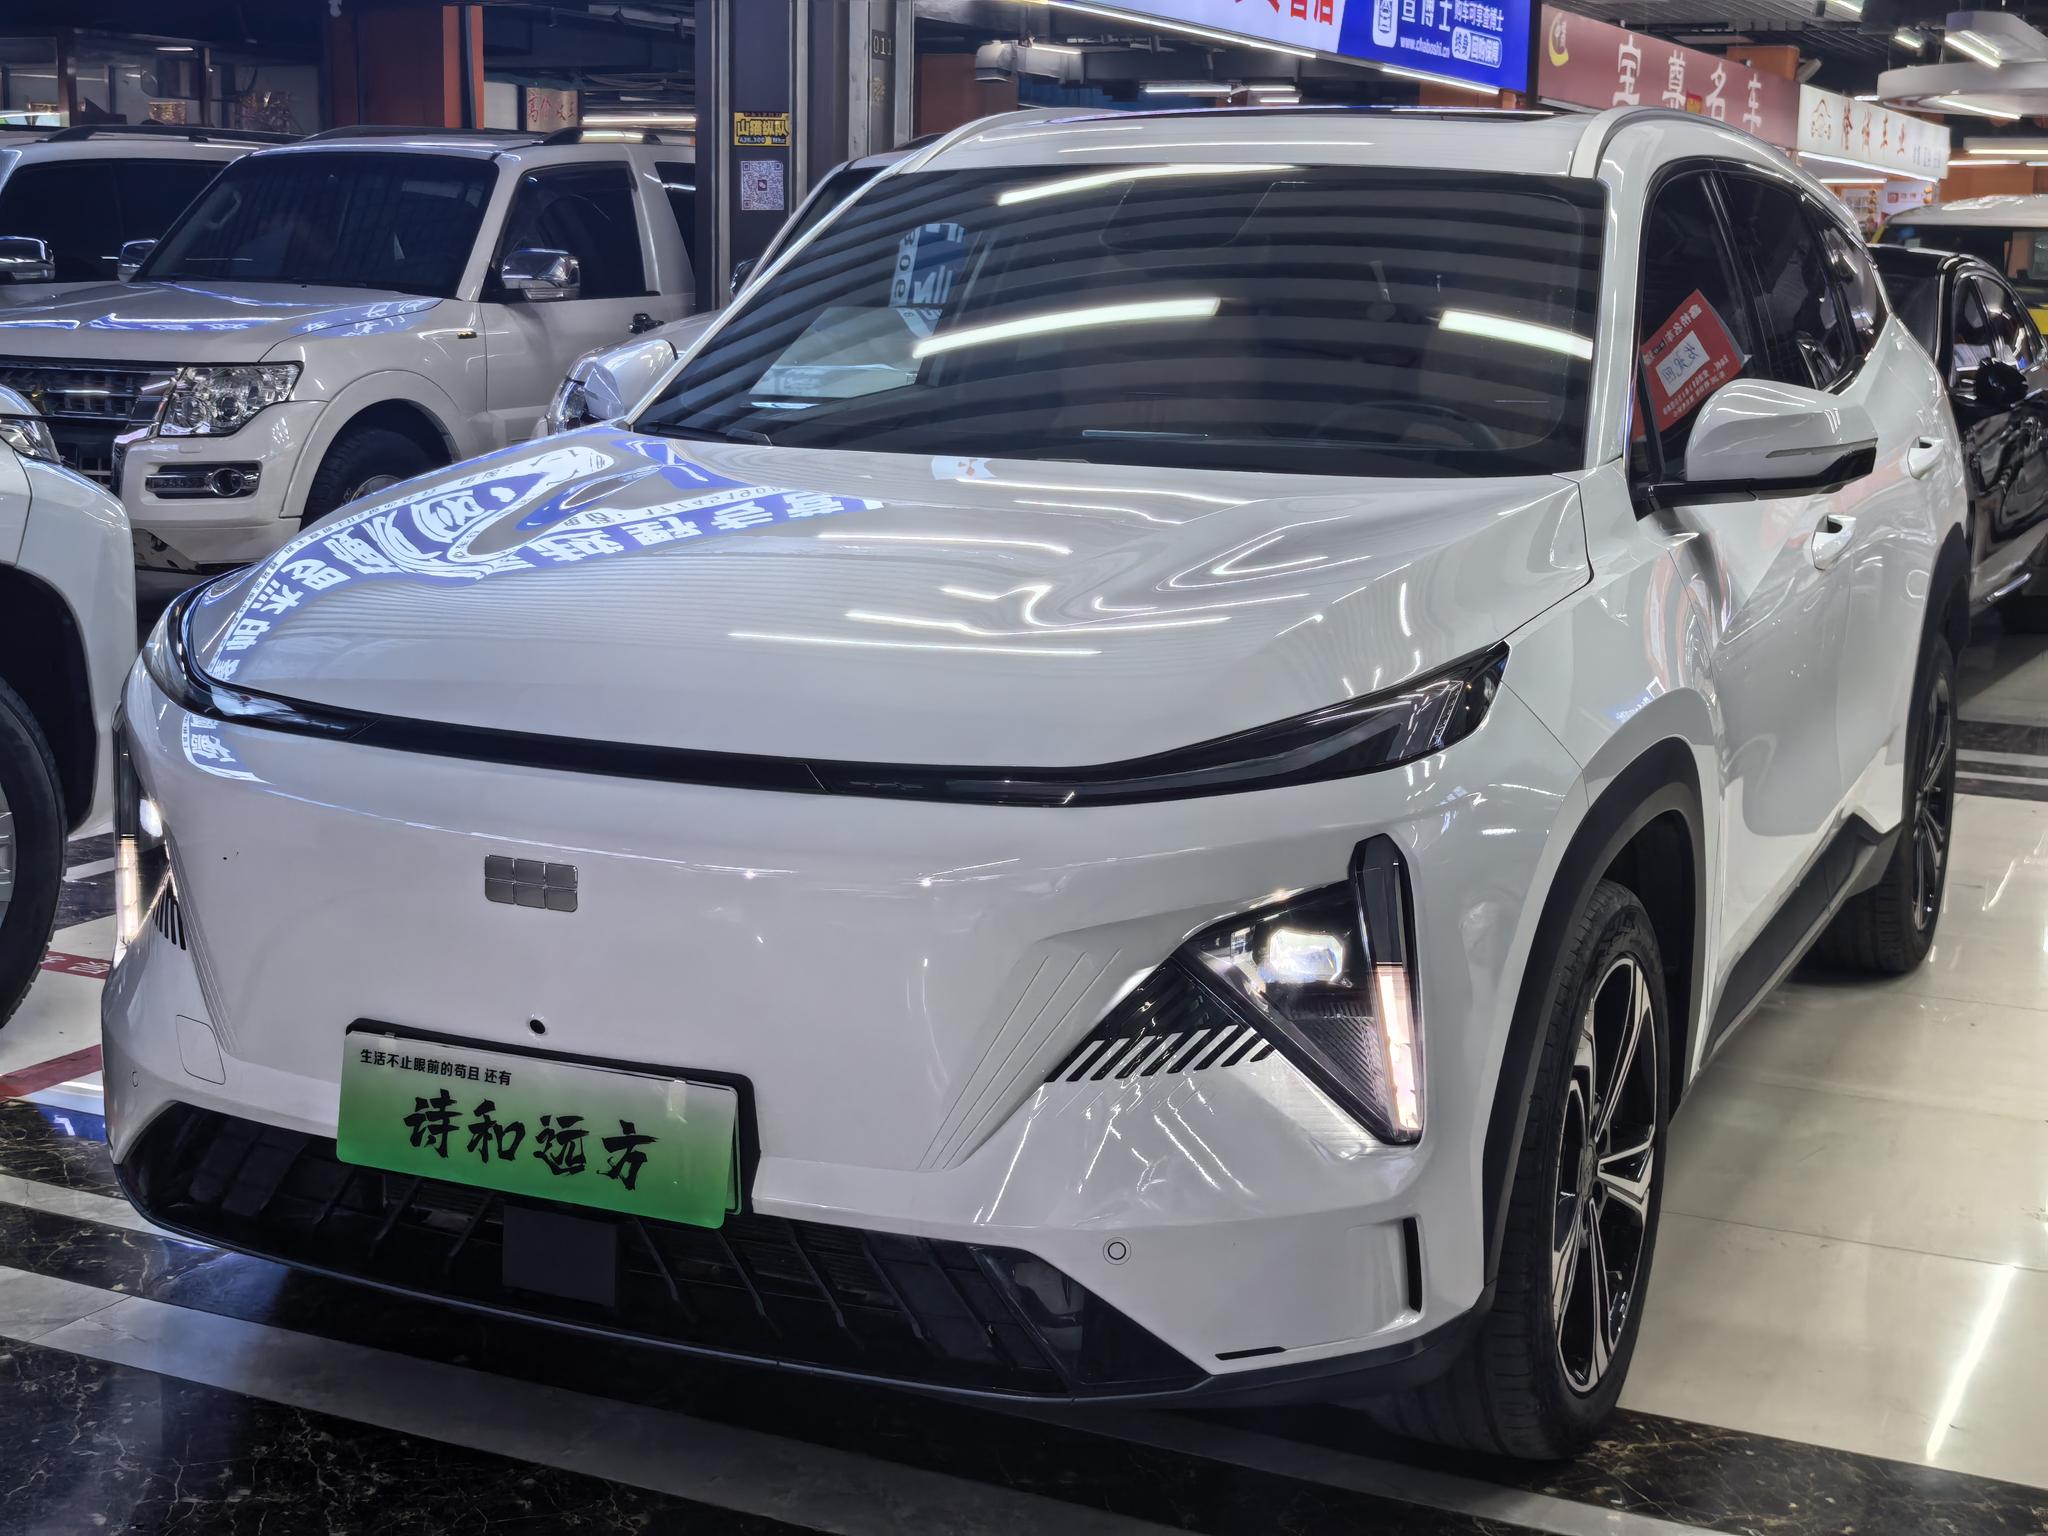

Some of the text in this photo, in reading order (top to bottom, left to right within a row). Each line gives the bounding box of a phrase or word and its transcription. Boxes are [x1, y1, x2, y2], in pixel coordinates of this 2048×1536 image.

[360, 1049, 512, 1086] 生活不止眼前的苟且 还有
[403, 1088, 660, 1191] 诗和远方
